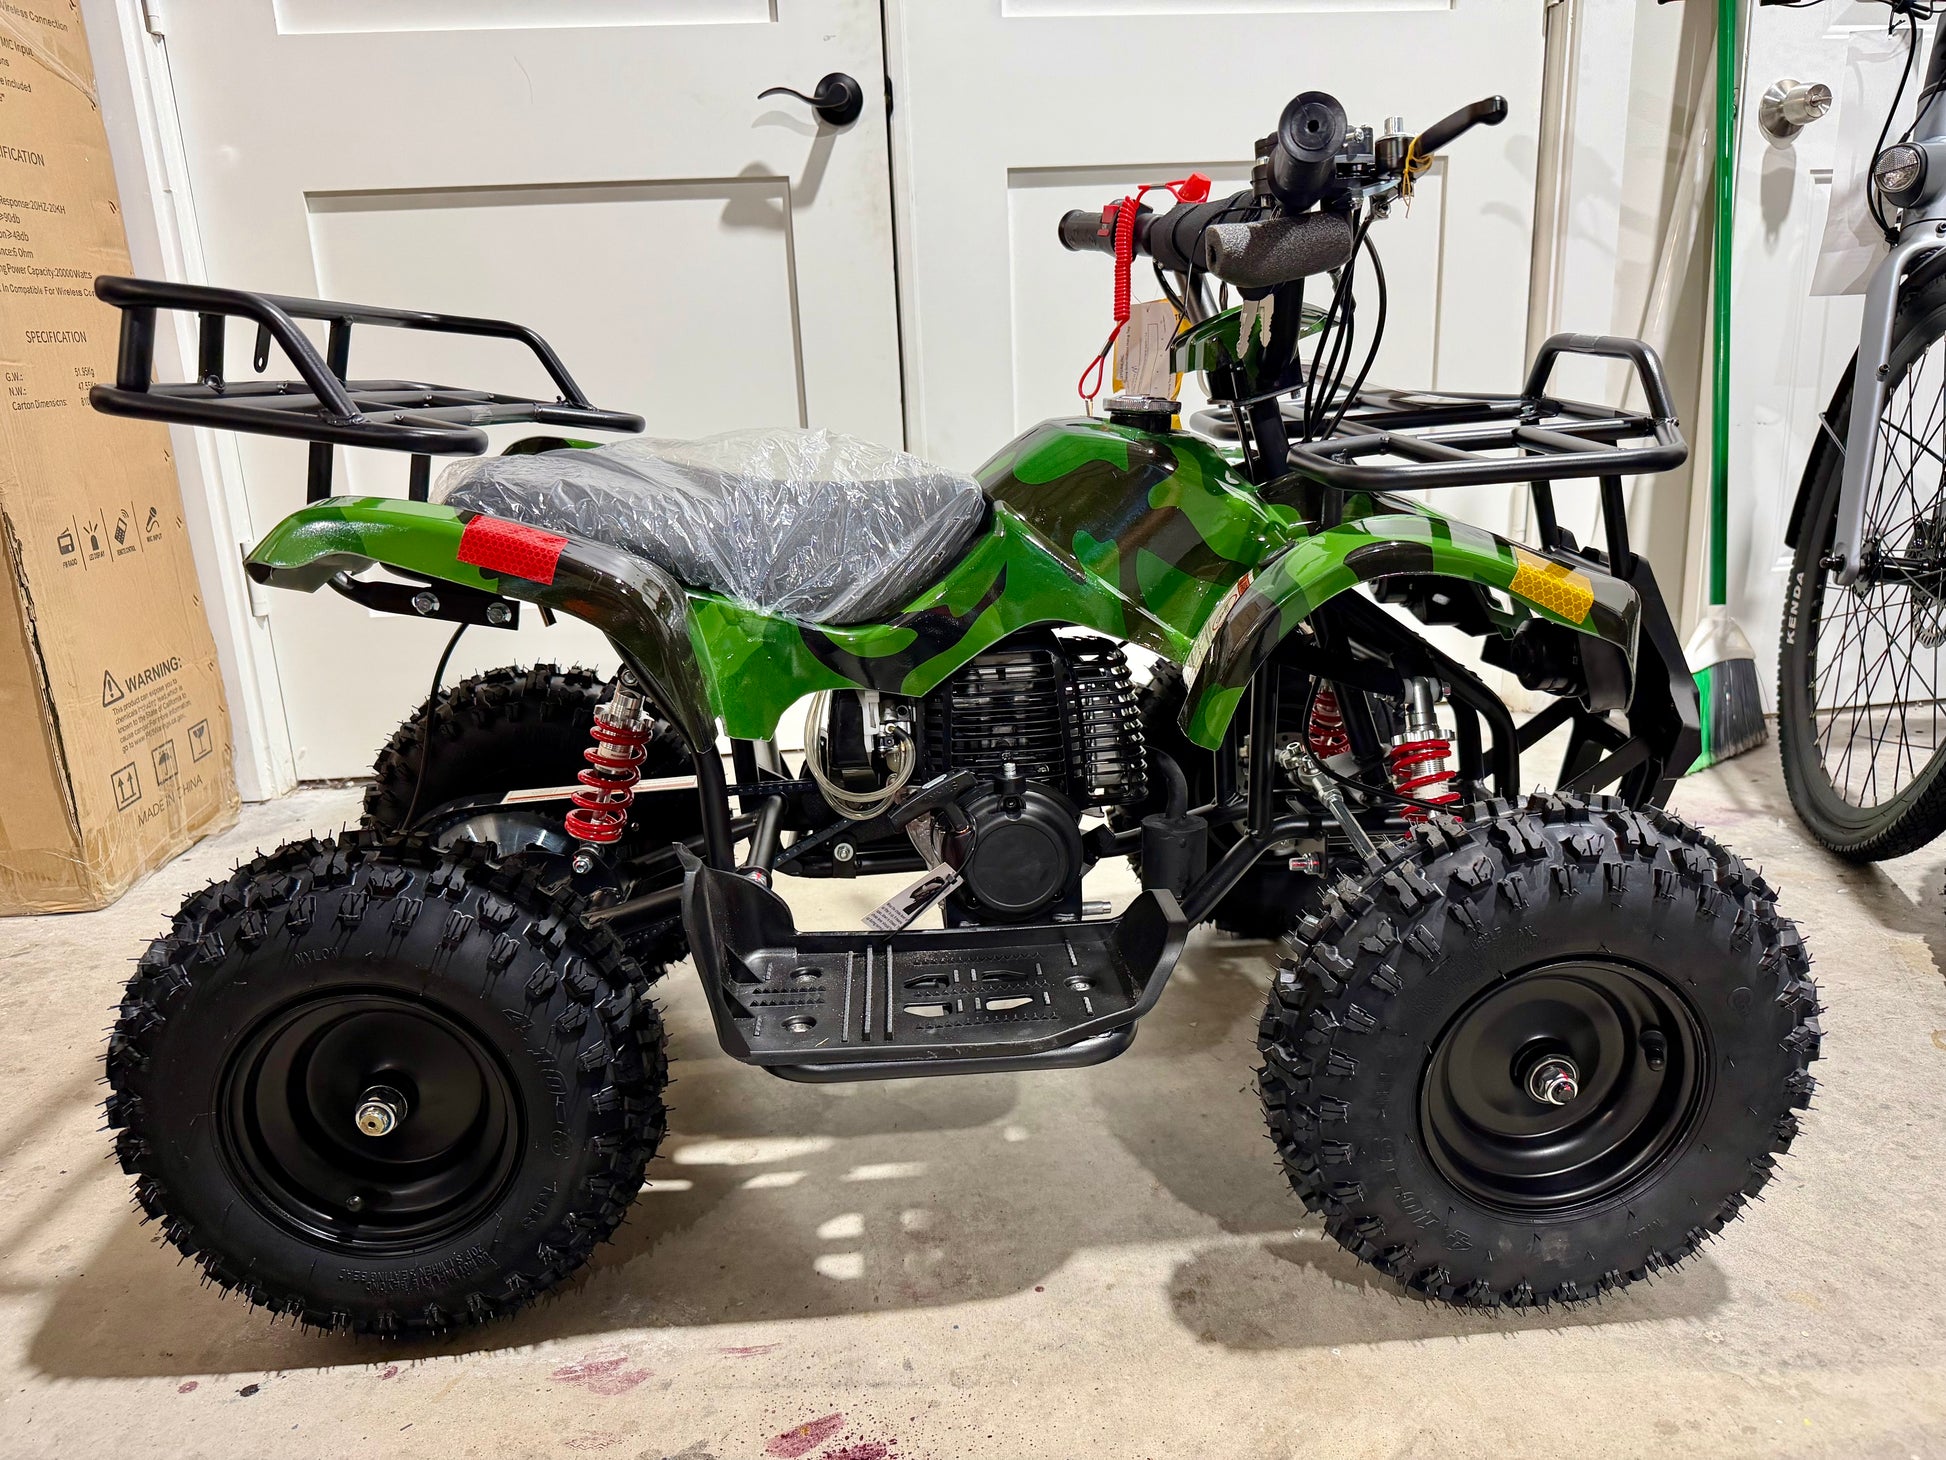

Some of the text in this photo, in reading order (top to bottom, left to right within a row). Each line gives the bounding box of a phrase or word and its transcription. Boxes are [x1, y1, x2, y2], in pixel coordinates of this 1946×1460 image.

[29, 11, 69, 32] Connection
[17, 246, 34, 258] Ohm
[7, 263, 26, 275] Power
[44, 286, 55, 295] For
[55, 286, 82, 297] Wireless
[25, 330, 87, 344] SPECIFICATION
[12, 400, 35, 411] Carton
[1786, 572, 1805, 645] KENDA
[125, 657, 182, 693] WARNING:
[138, 774, 203, 827] MADE IN CHINA
